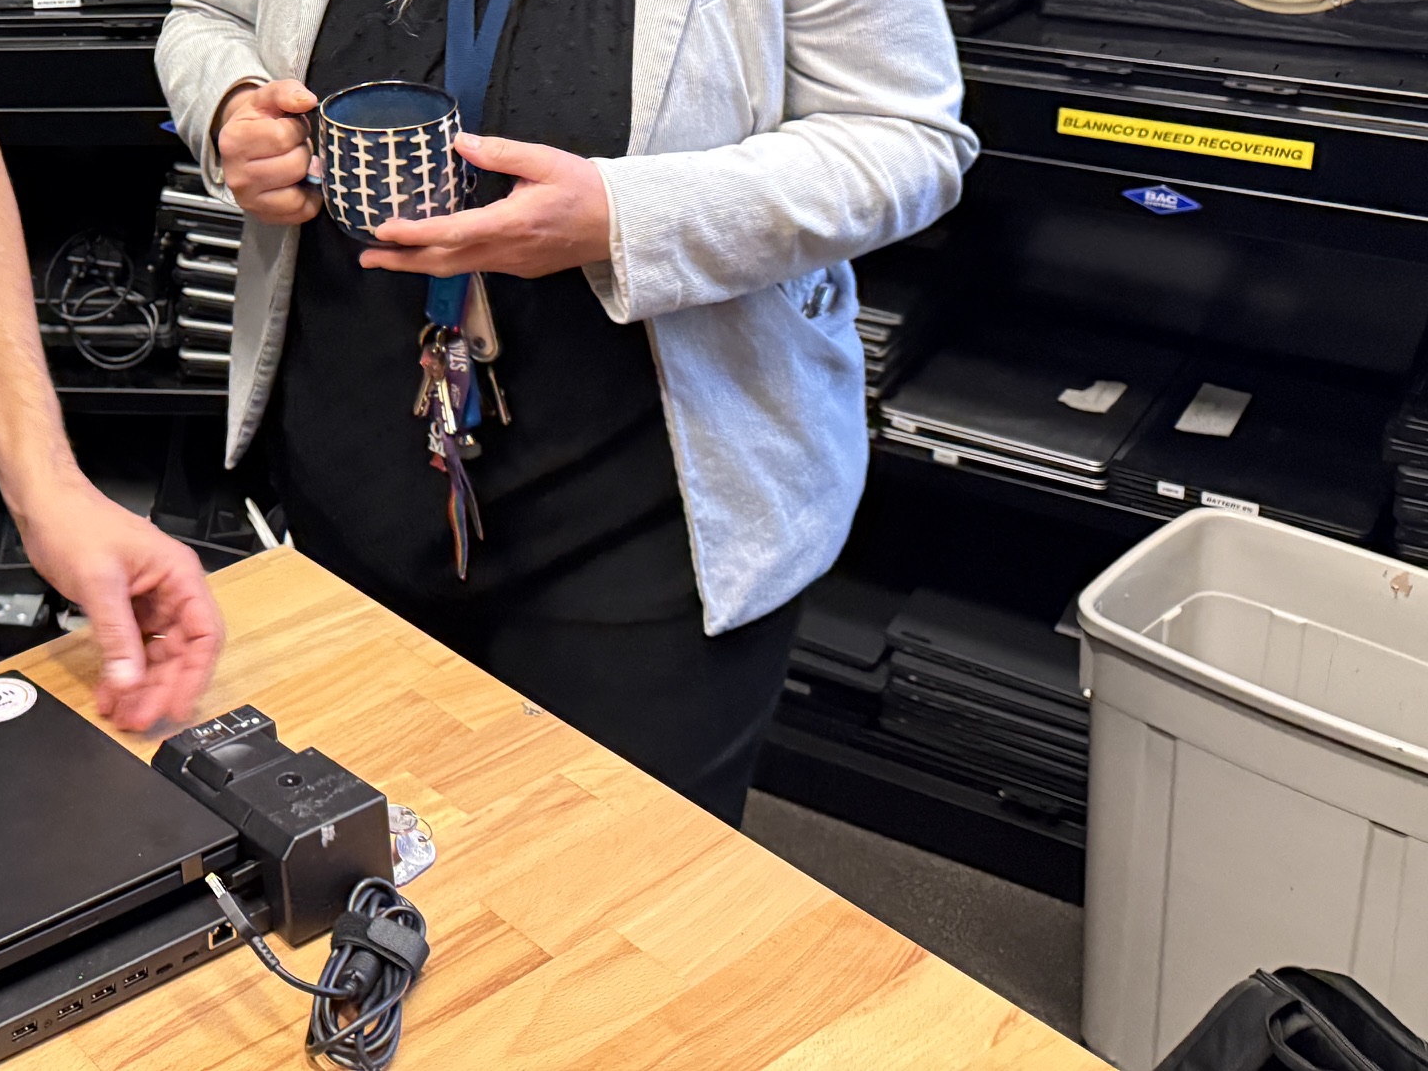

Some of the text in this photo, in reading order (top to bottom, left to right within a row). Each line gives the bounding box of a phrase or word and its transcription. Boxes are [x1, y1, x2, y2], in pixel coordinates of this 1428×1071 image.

[1062, 116, 1304, 162] BLANNCO'D NEED RECOVERING
[1206, 496, 1241, 510] BATTERY
